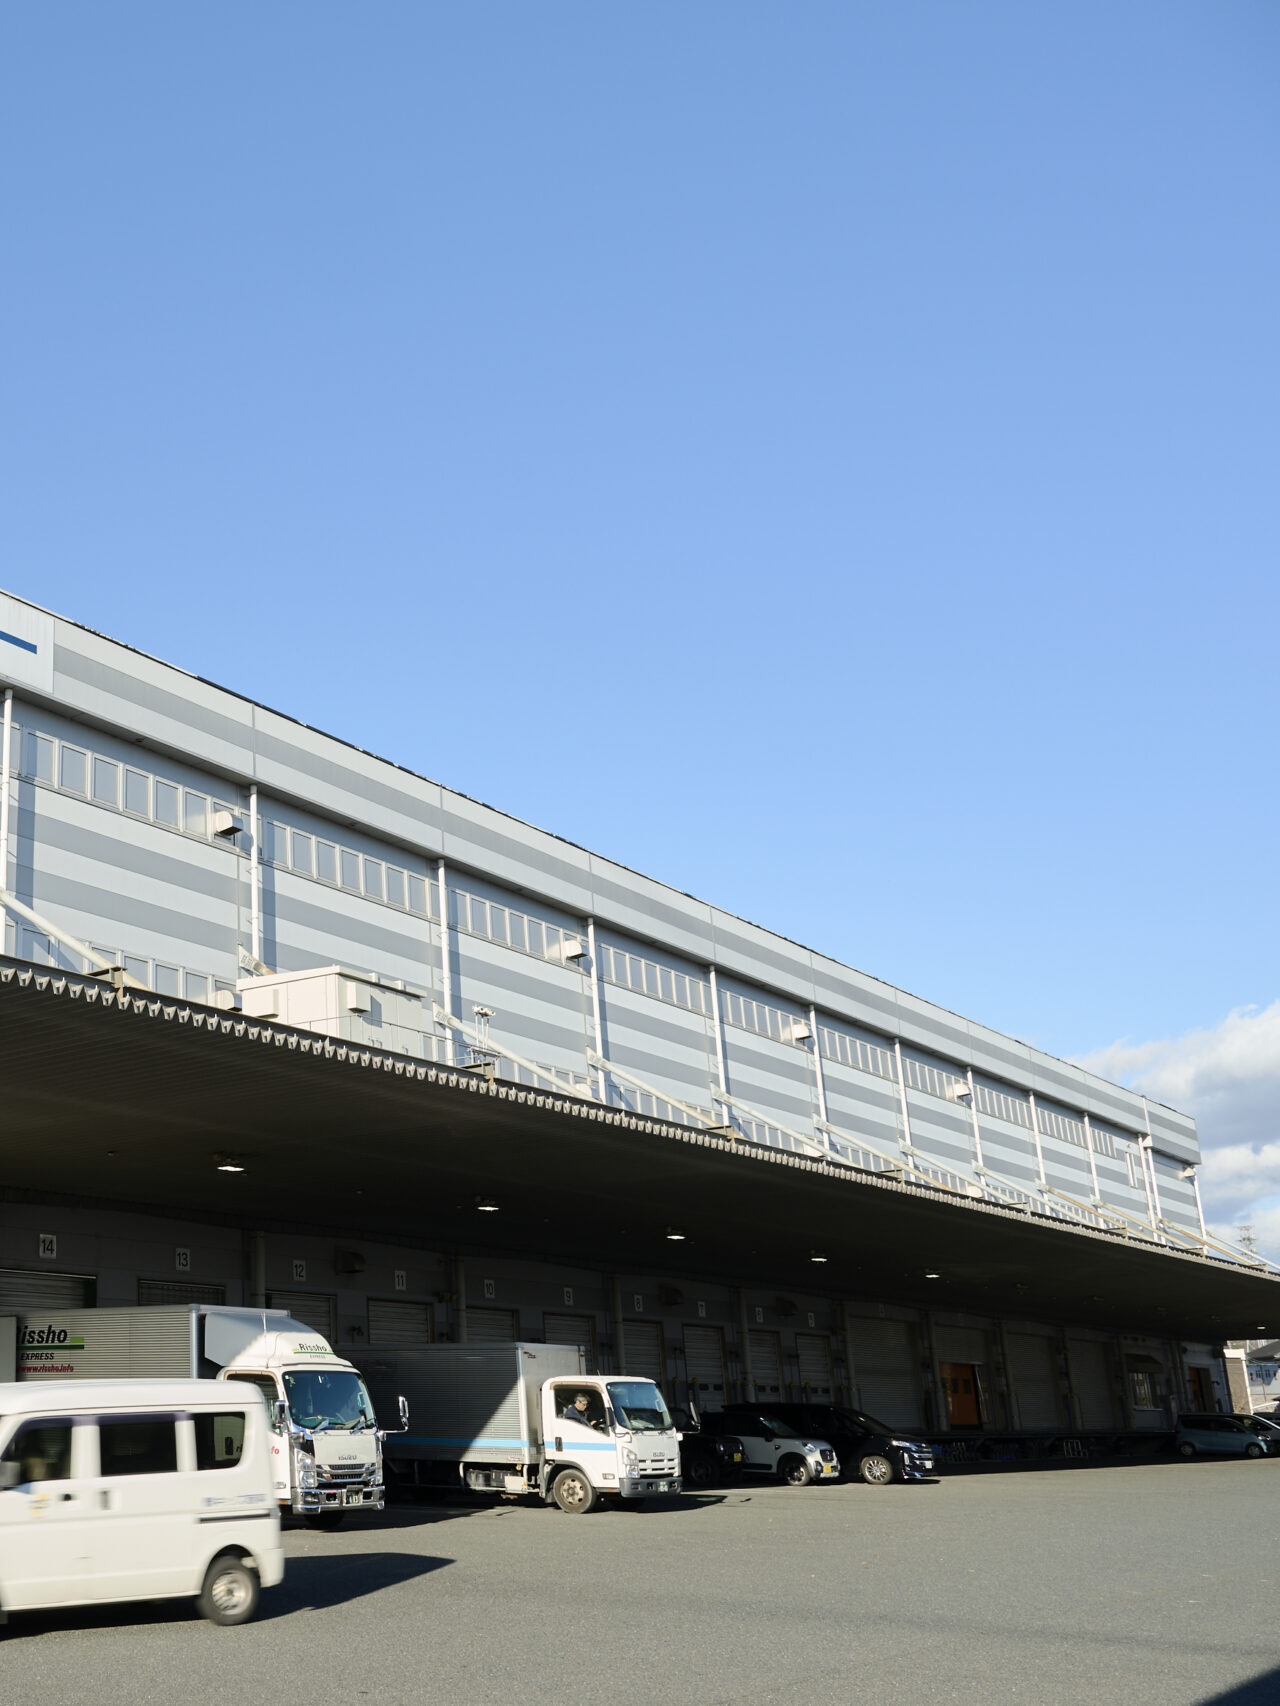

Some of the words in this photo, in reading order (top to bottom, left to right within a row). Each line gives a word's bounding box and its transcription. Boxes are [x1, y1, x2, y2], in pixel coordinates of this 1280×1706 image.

[41, 1238, 55, 1255] 14
[176, 1252, 189, 1268] 13
[293, 1263, 305, 1278] 12
[396, 1274, 404, 1288] 11
[485, 1282, 494, 1296] 10
[298, 1343, 328, 1352] Rissho
[20, 1352, 55, 1361] EXPRESS
